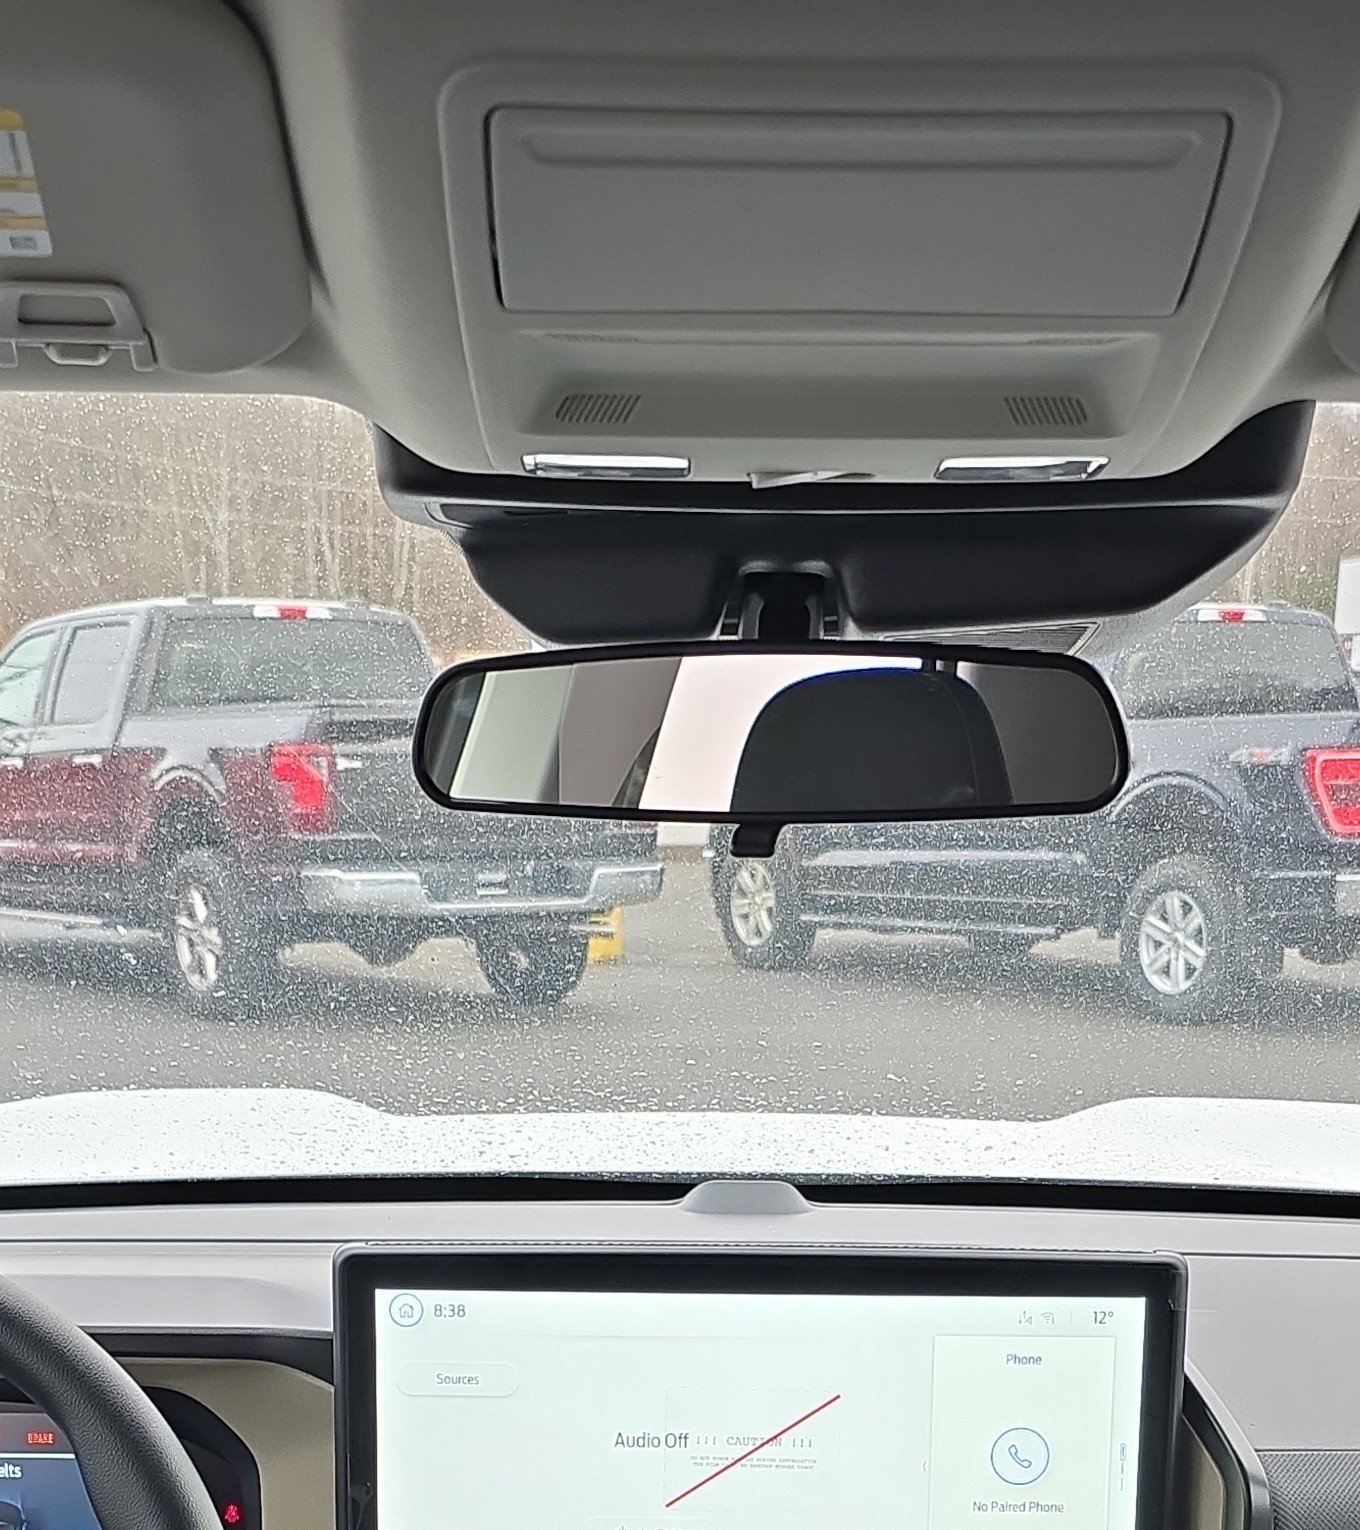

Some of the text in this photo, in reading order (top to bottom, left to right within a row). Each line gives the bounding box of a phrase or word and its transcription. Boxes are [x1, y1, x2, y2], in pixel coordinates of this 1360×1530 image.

[434, 1304, 466, 1318] 8:38
[1093, 1310, 1114, 1324] 12°
[1006, 1354, 1042, 1365] Phone
[436, 1373, 480, 1386] Sources
[614, 1432, 689, 1449] Audio Off
[972, 1501, 1064, 1513] No Paired Phone
